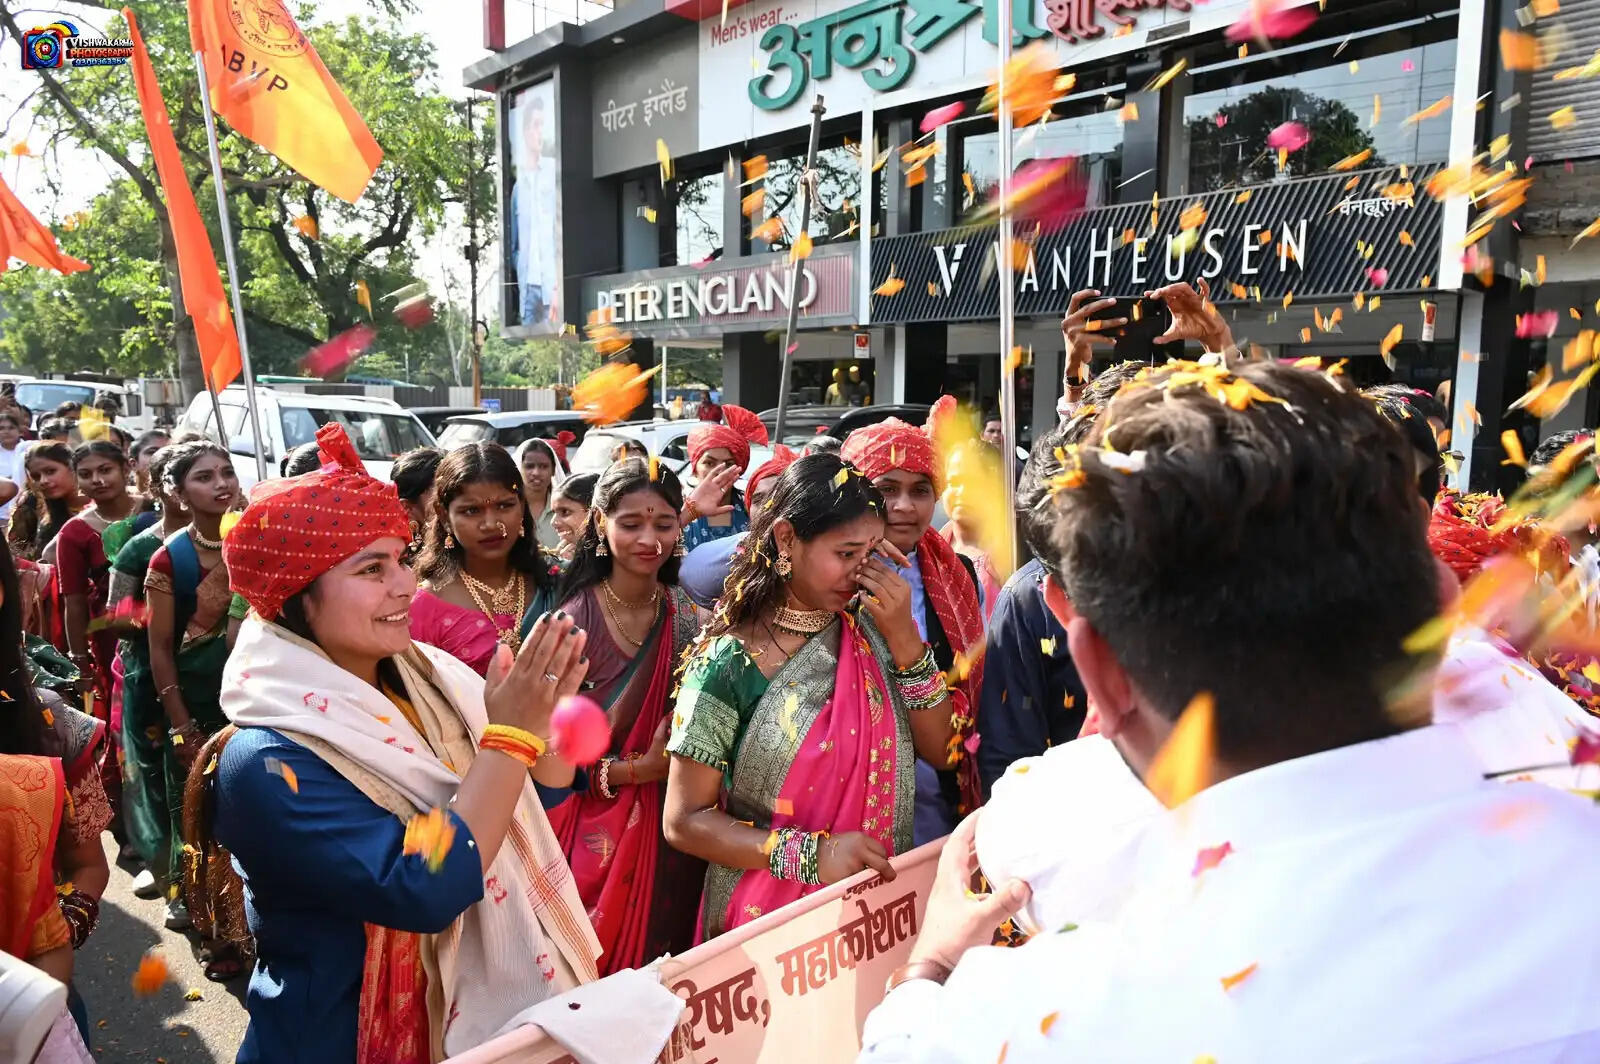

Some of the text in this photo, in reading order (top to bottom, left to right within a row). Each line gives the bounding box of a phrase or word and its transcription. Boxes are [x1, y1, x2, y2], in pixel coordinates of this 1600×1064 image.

[711, 17, 747, 48] Men's
[601, 78, 689, 133] पीटर इंग्लैंड
[597, 268, 818, 325] PETER ENGLAND
[655, 890, 918, 1064] रिषद, महाकोशल
